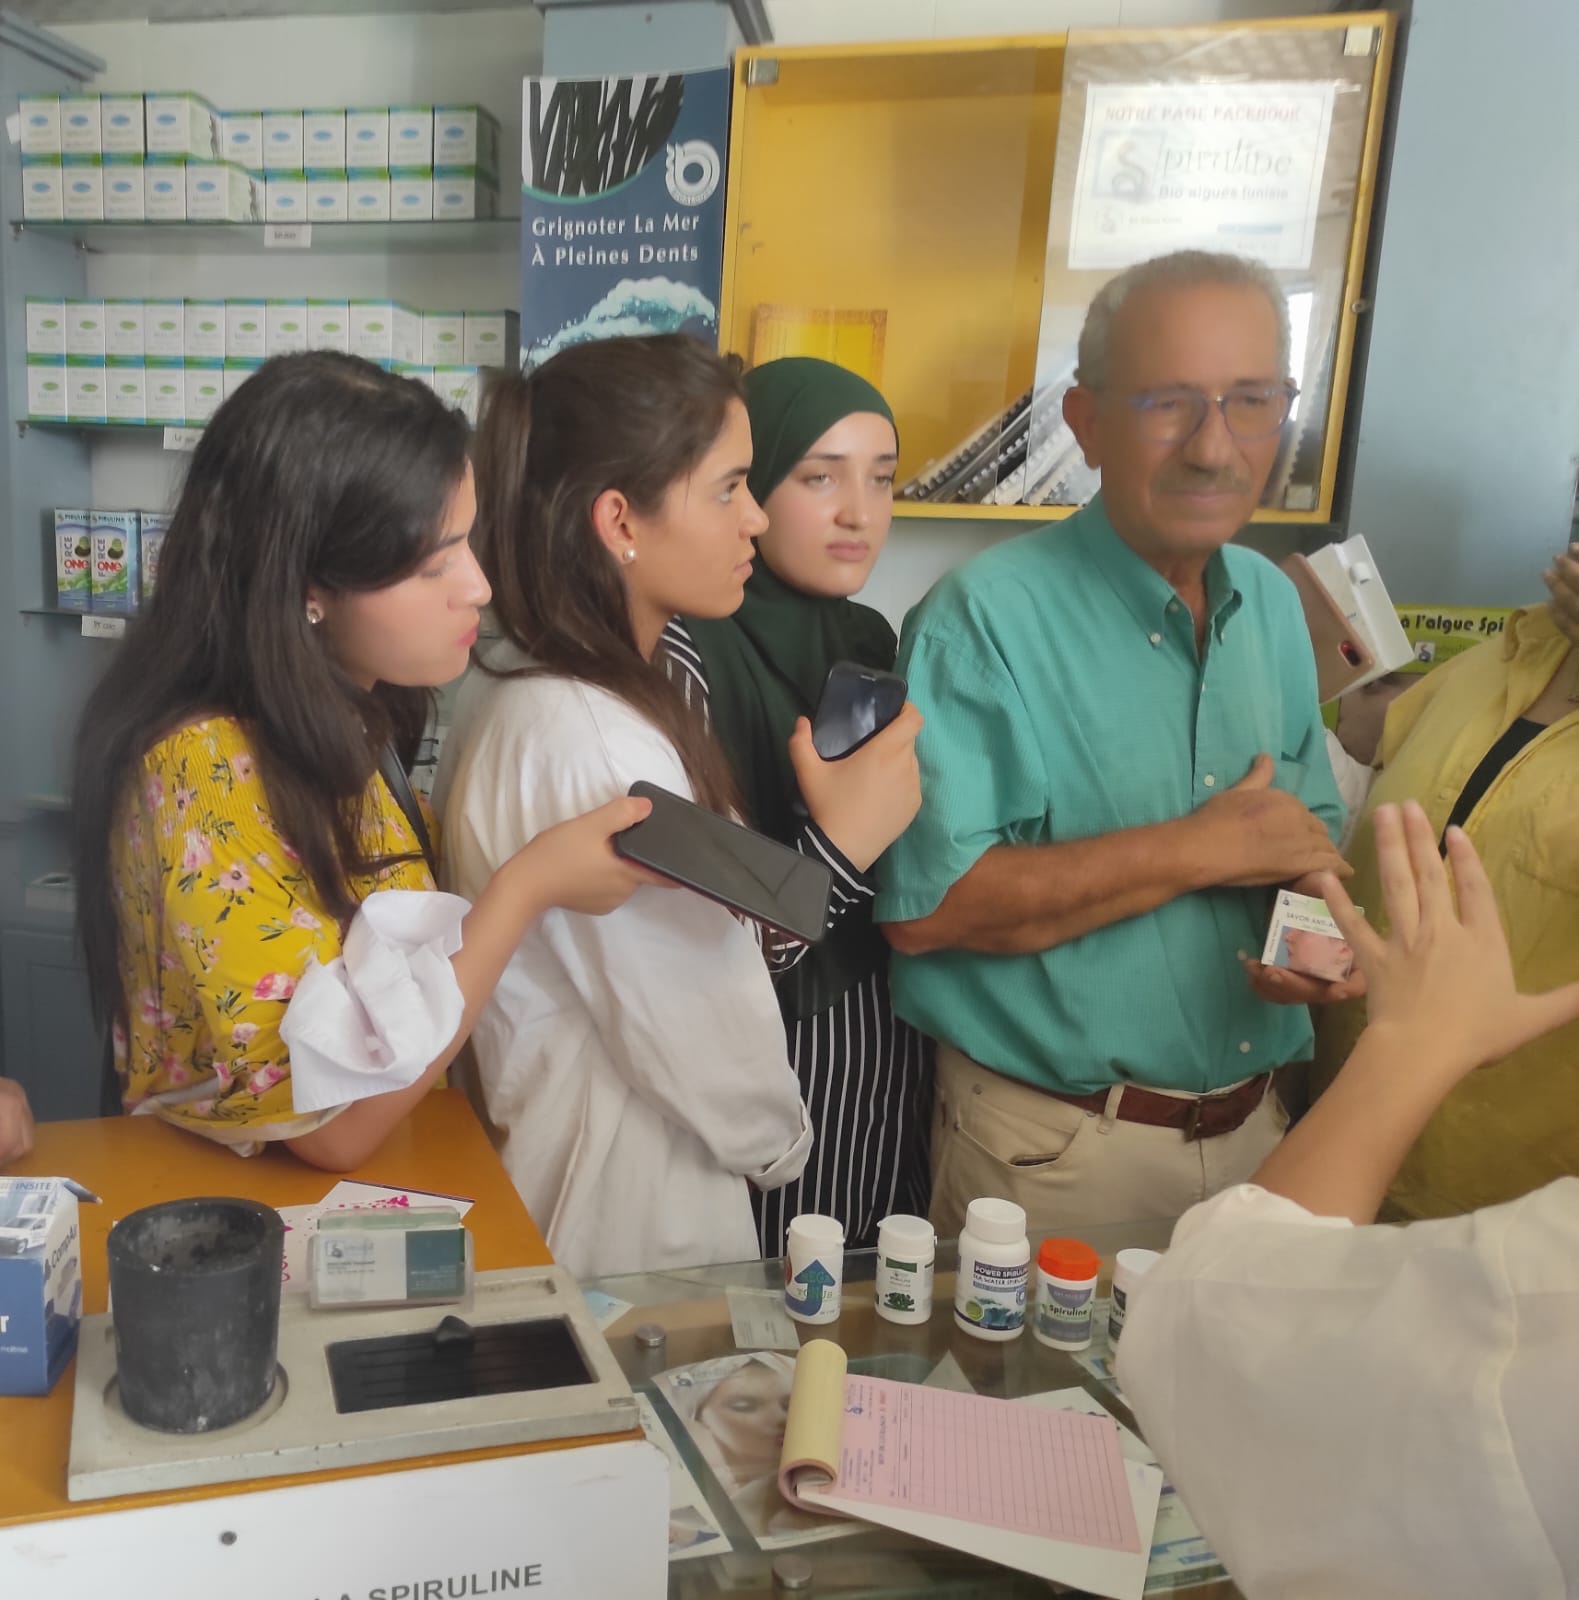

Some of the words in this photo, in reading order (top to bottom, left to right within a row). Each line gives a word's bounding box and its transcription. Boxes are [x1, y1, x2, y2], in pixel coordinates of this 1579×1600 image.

[531, 216, 625, 241] Grignoter
[634, 214, 654, 233] La
[662, 212, 700, 232] Mer
[531, 242, 545, 266] À
[555, 246, 629, 266] Pleines
[639, 243, 698, 264] Dents
[1415, 615, 1474, 634] l'algue
[1478, 616, 1504, 634] Spi
[975, 1265, 1002, 1277] POWER
[1049, 1305, 1088, 1317] Spiruline
[368, 1563, 542, 1600] SPIRULINE
